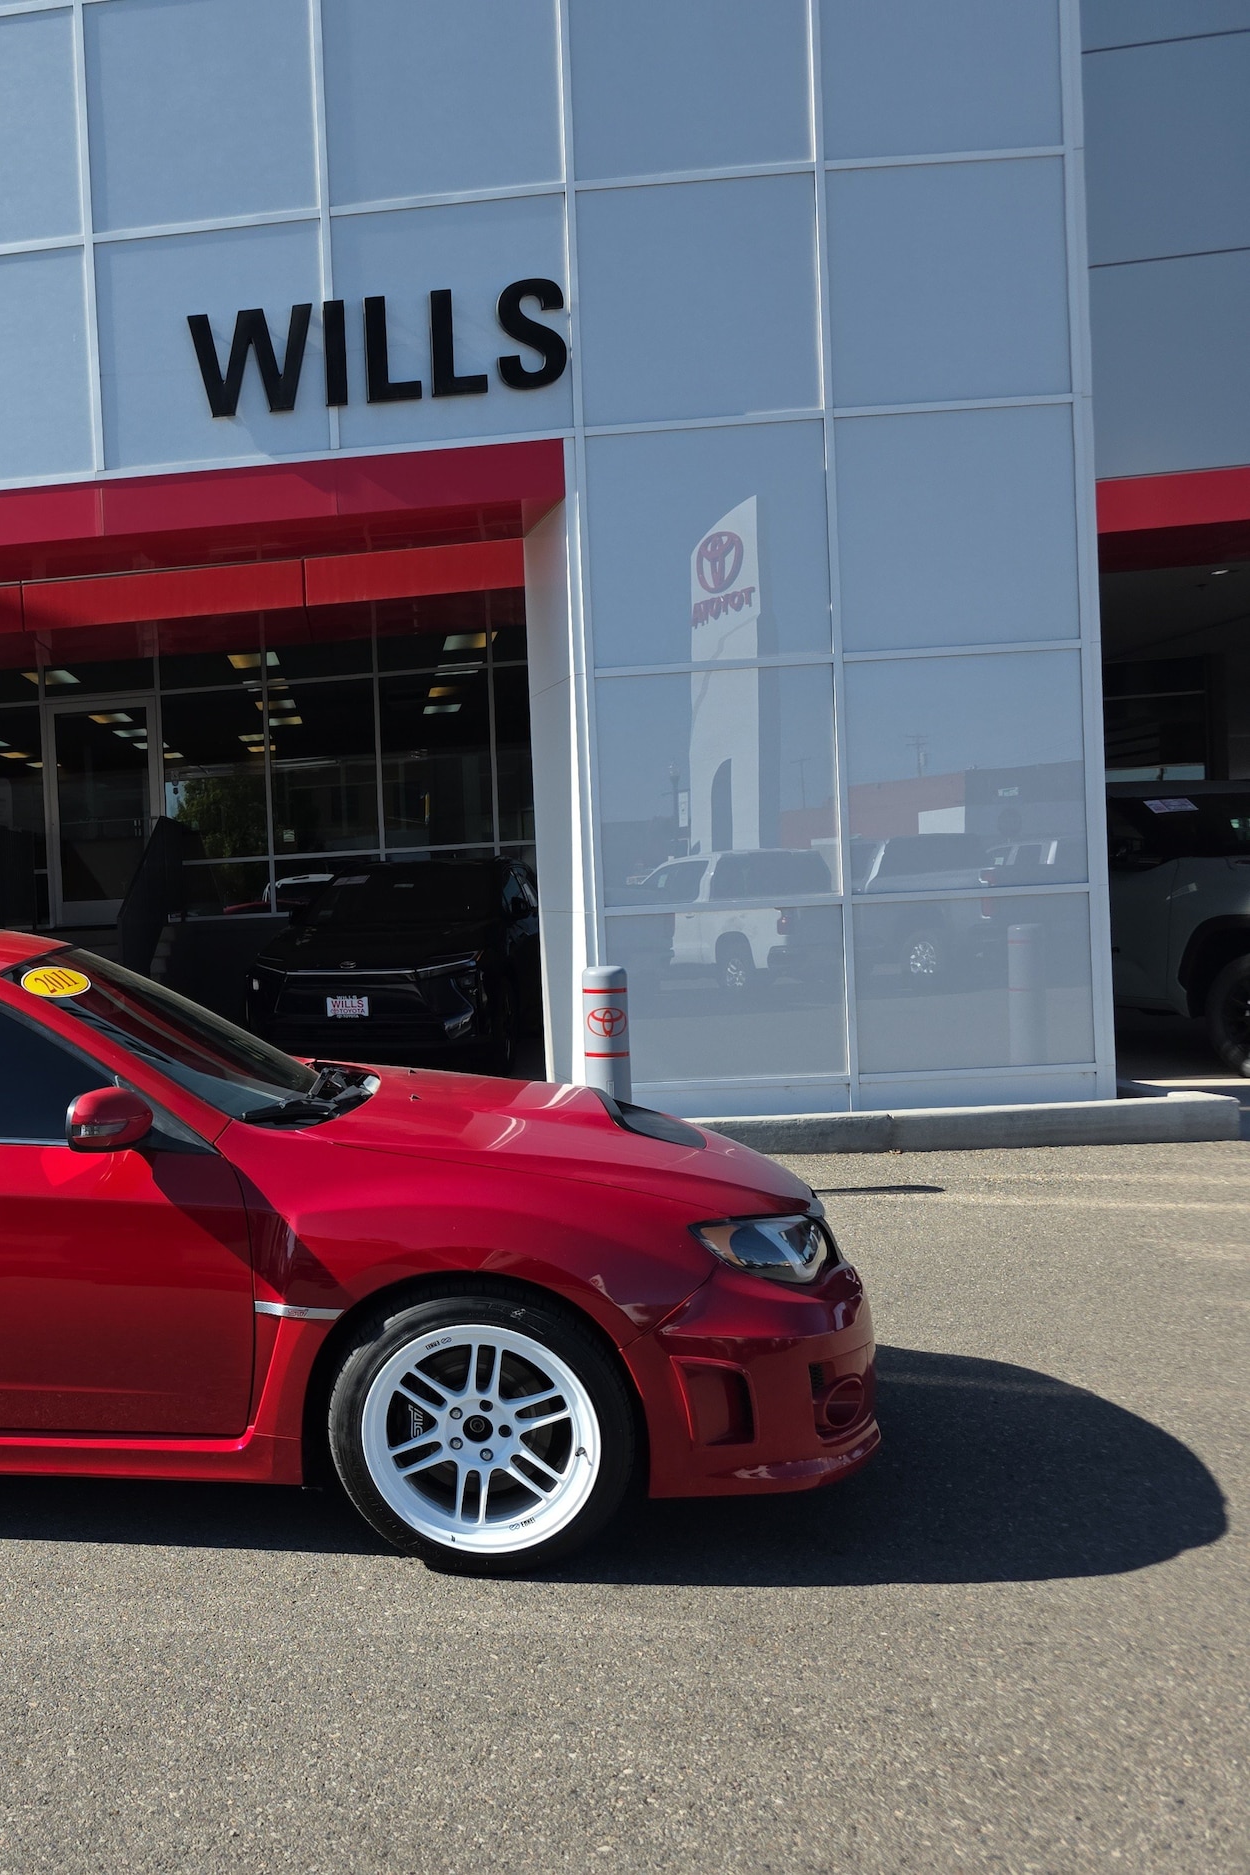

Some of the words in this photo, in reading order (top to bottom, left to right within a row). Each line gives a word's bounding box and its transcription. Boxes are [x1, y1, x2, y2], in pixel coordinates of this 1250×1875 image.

[187, 278, 567, 418] WILLS
[34, 969, 79, 994] 2011
[331, 1000, 364, 1008] WILLS
